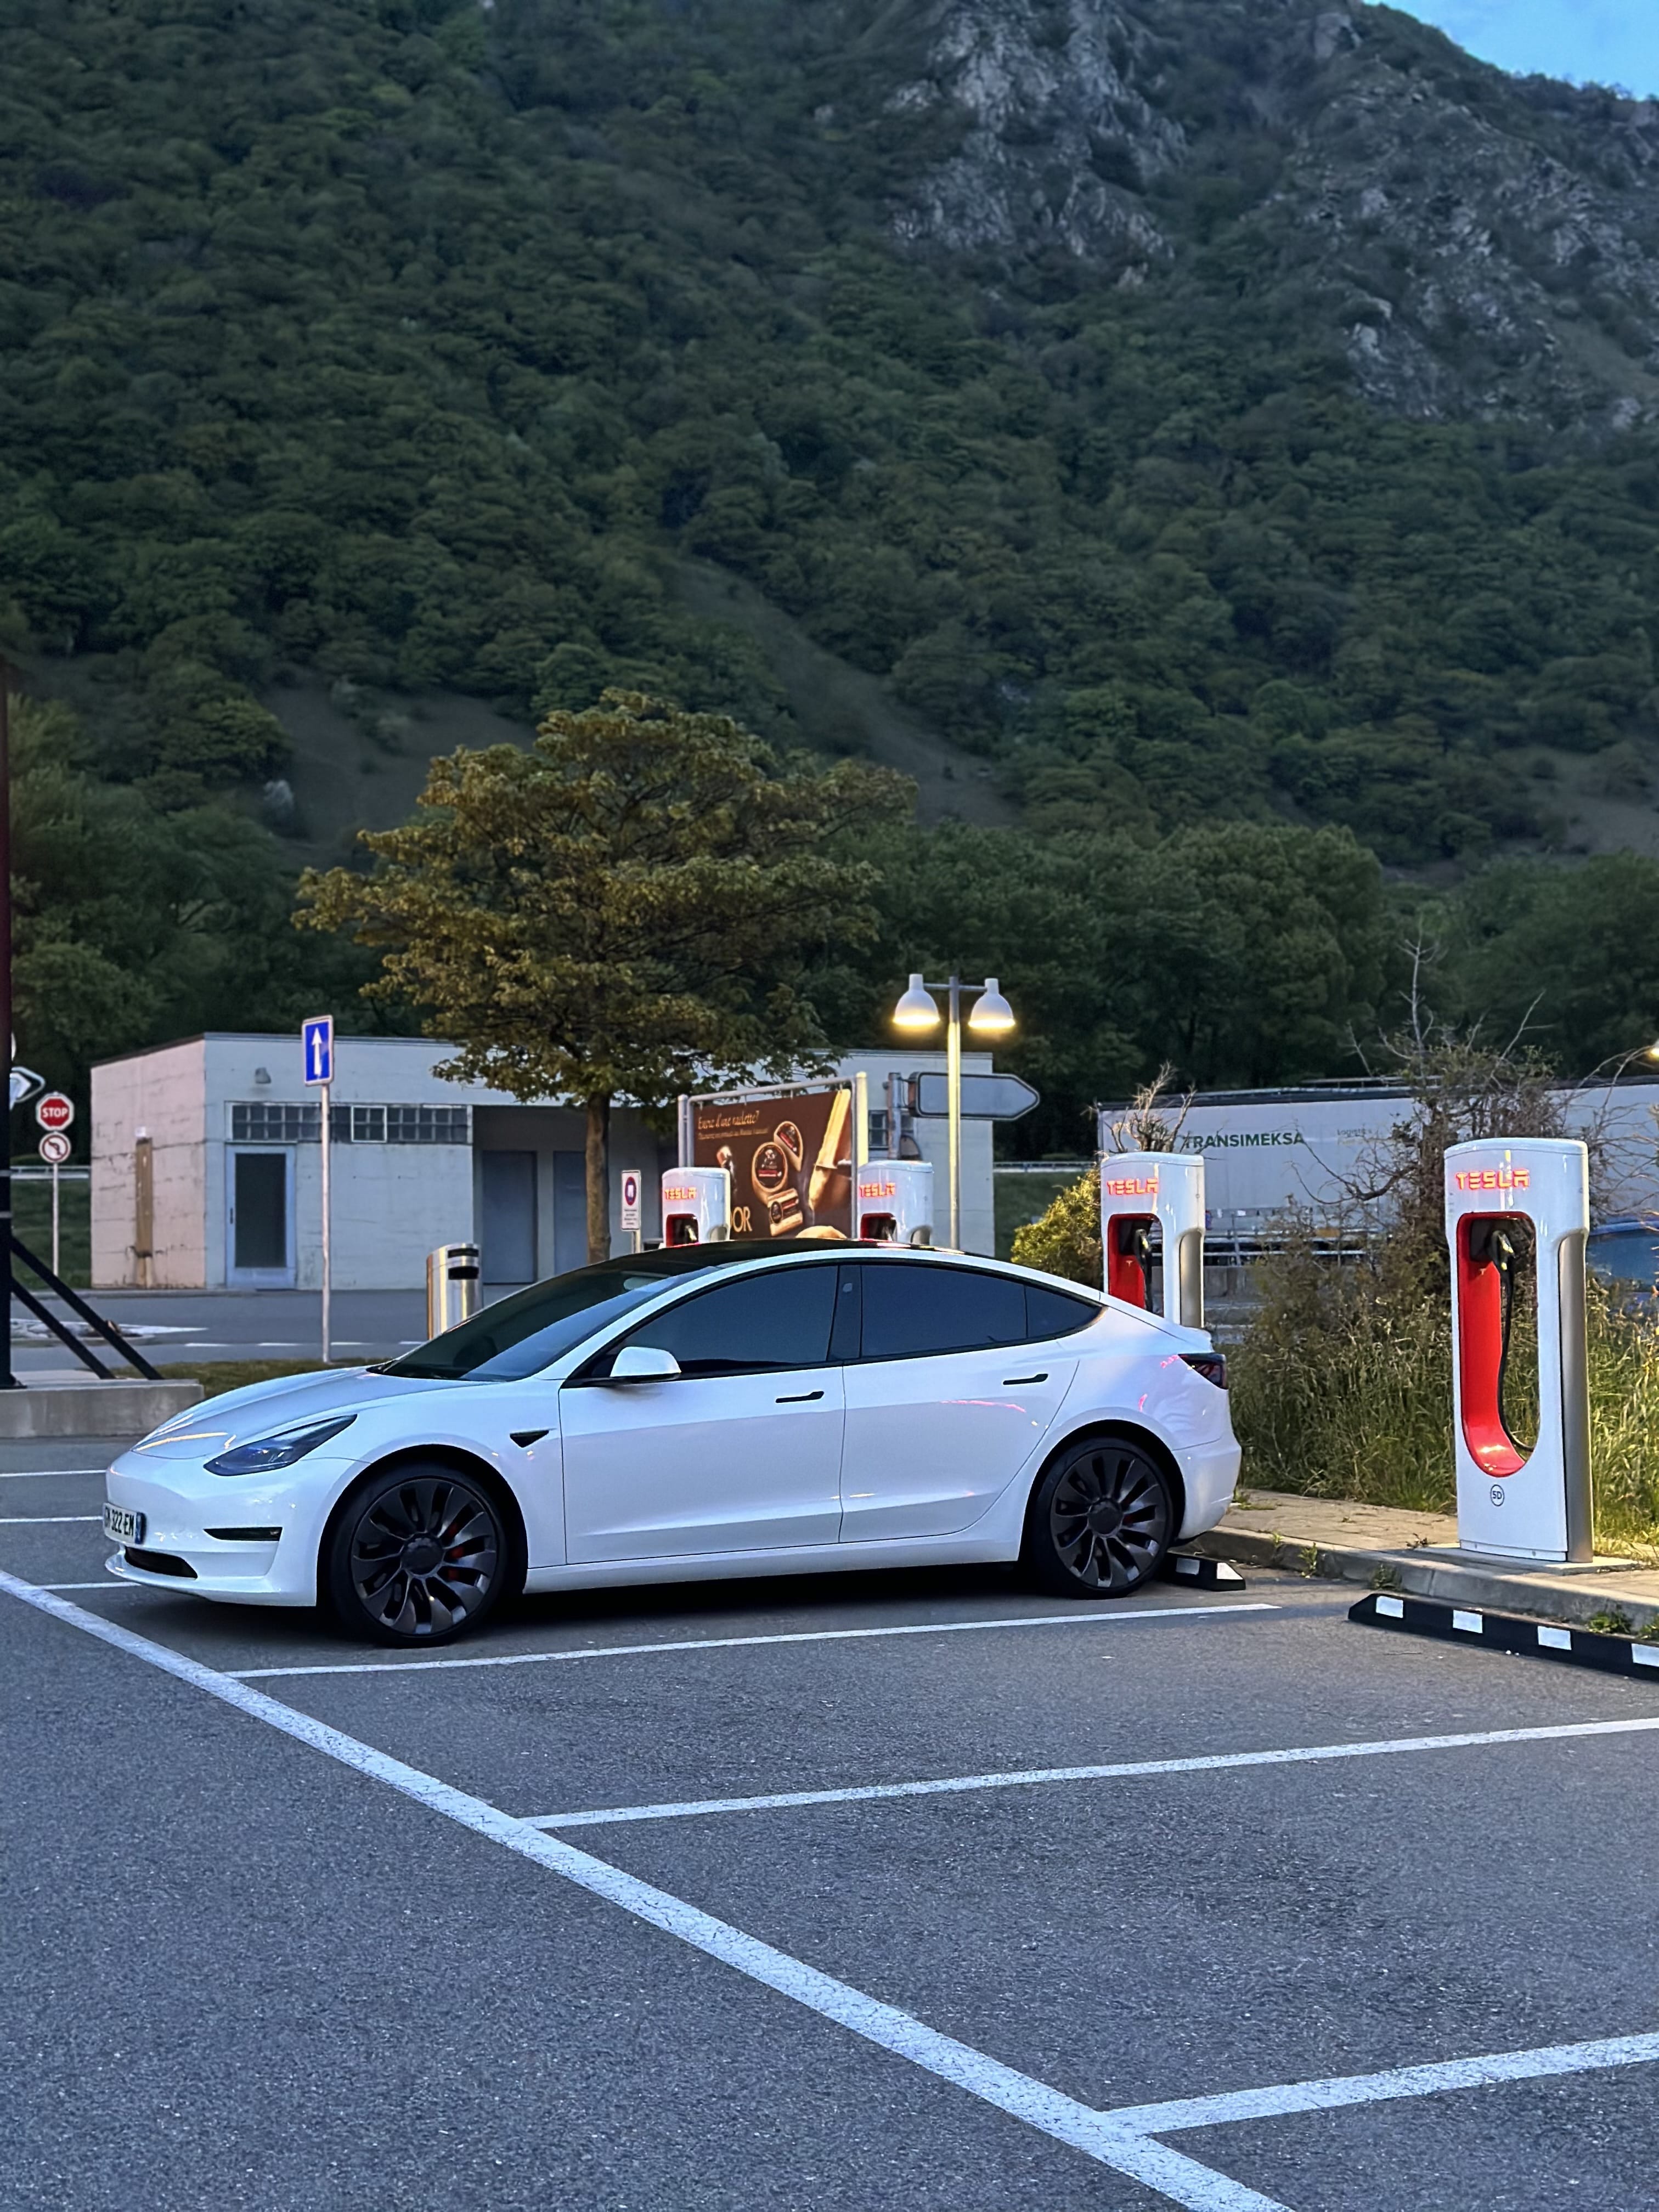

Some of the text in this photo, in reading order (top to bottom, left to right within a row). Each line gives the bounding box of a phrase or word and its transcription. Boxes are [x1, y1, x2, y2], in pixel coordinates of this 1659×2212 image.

[42, 1107, 69, 1118] STOP
[1182, 1132, 1305, 1148] TRANSIMEKSA
[1107, 1178, 1158, 1195] TESLA
[1455, 1169, 1530, 1190] TESLA
[664, 1187, 697, 1200] TESLA
[859, 1182, 895, 1198] TESLA
[730, 1206, 753, 1233] OR
[1492, 1491, 1502, 1499] 5D
[111, 1509, 122, 1533] 322
[124, 1514, 134, 1537] EM
